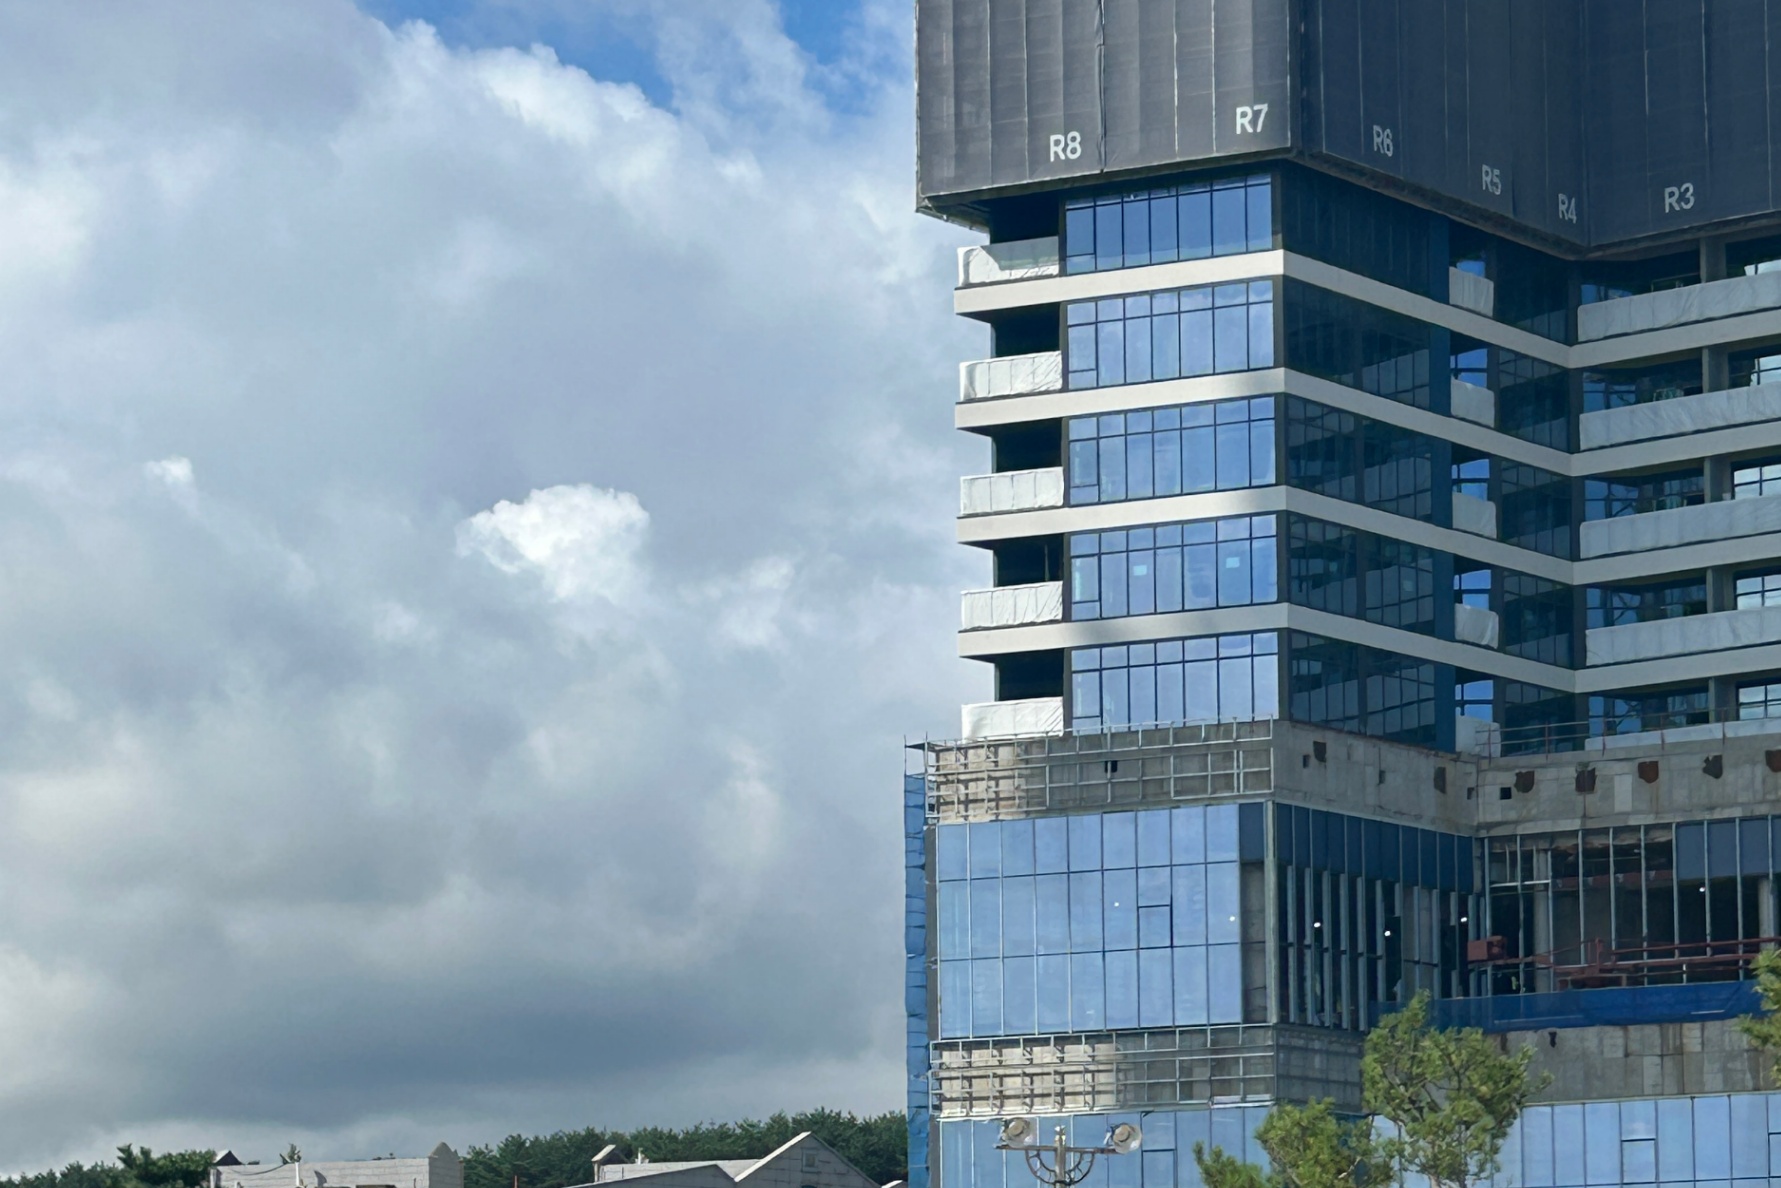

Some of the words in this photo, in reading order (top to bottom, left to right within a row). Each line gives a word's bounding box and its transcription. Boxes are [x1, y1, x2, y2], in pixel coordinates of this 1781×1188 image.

[1234, 103, 1270, 135] R7
[1048, 130, 1083, 161] R8
[1372, 124, 1394, 158] R6
[1481, 163, 1502, 196] R5
[1557, 192, 1578, 225] R4
[1664, 182, 1696, 214] R3
